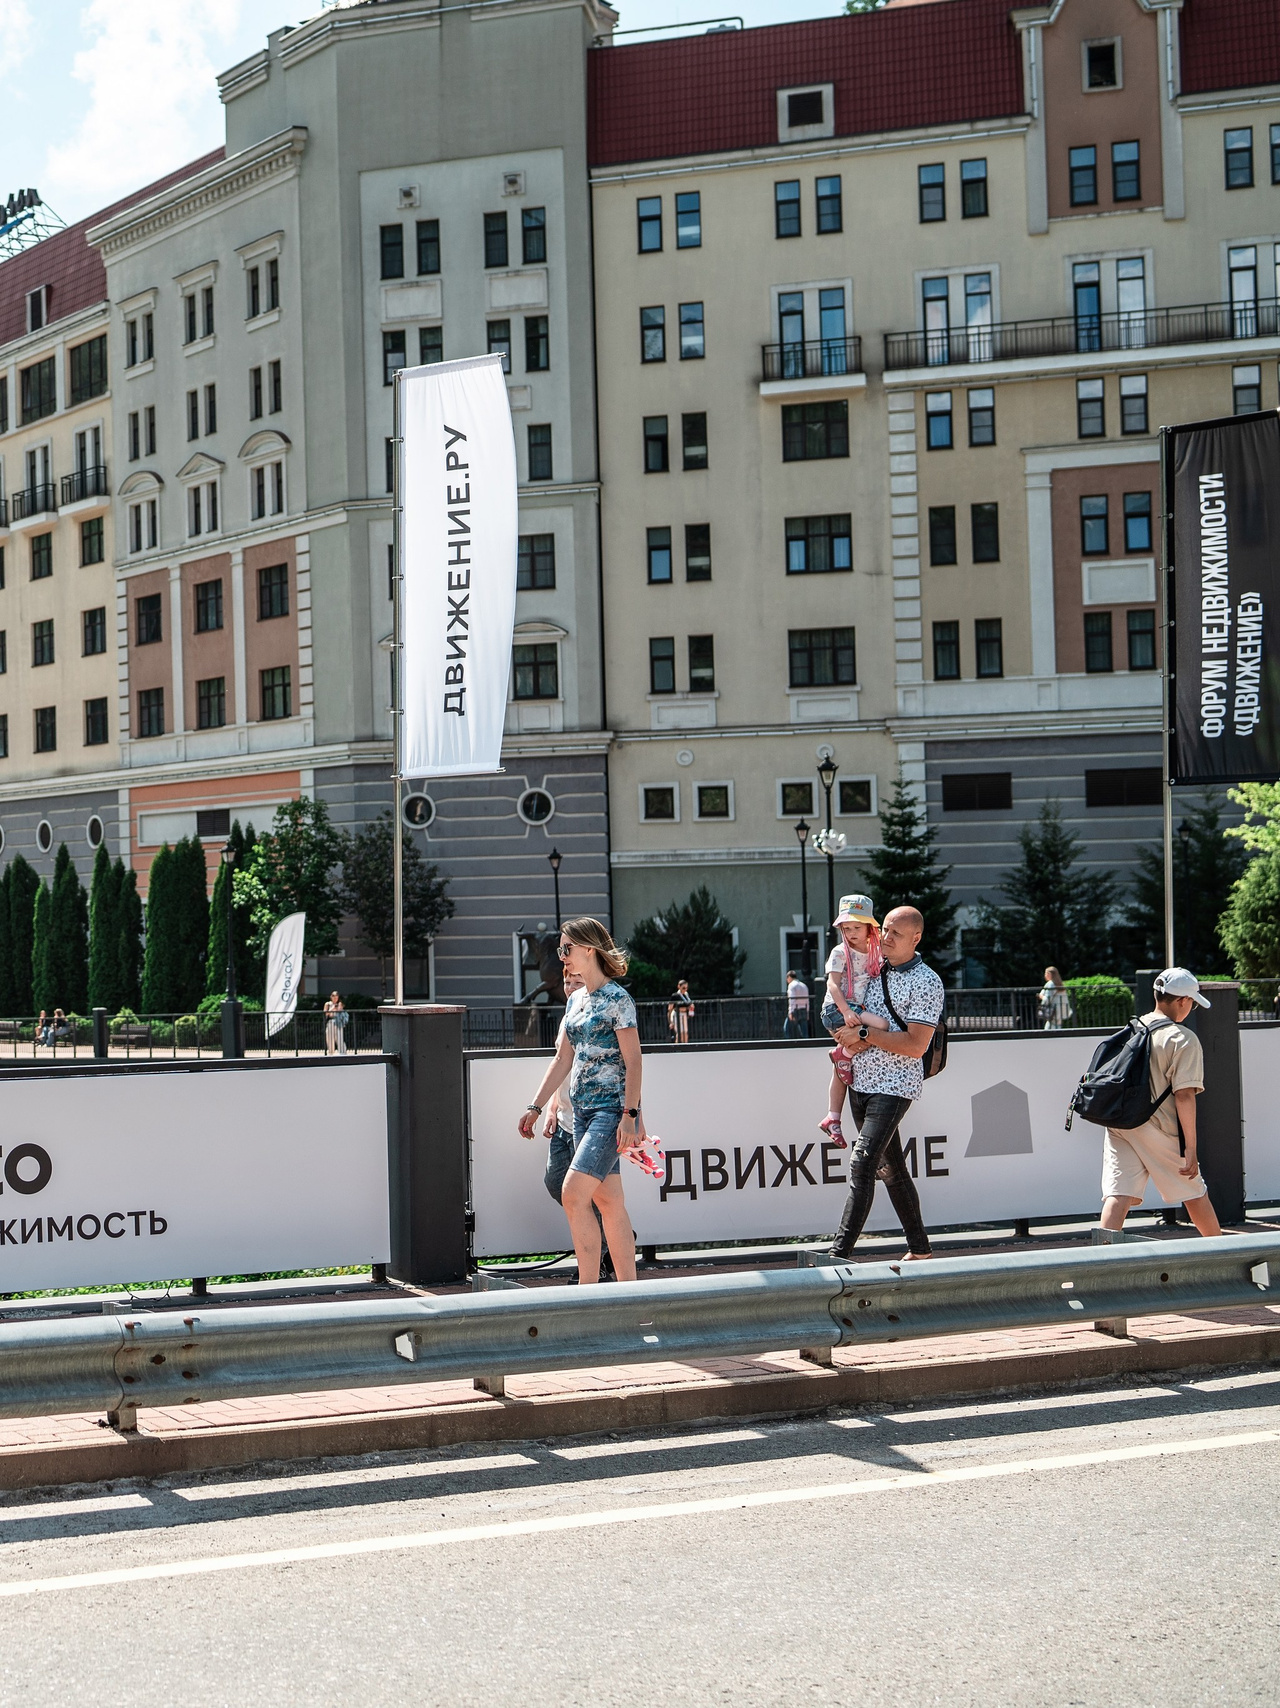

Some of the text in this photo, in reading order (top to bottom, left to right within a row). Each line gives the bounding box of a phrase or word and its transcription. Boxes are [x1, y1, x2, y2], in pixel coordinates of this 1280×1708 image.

[443, 424, 471, 717] ДВИЖЕНИЕ.РУ
[1198, 472, 1232, 738] ФОРУМ НЕДВИЖИМОСТИ
[1233, 591, 1263, 737] «ДВИЖЕНИЕ»
[281, 952, 293, 1003] GloraX
[659, 1135, 950, 1203] ДВИЖЕИЕ
